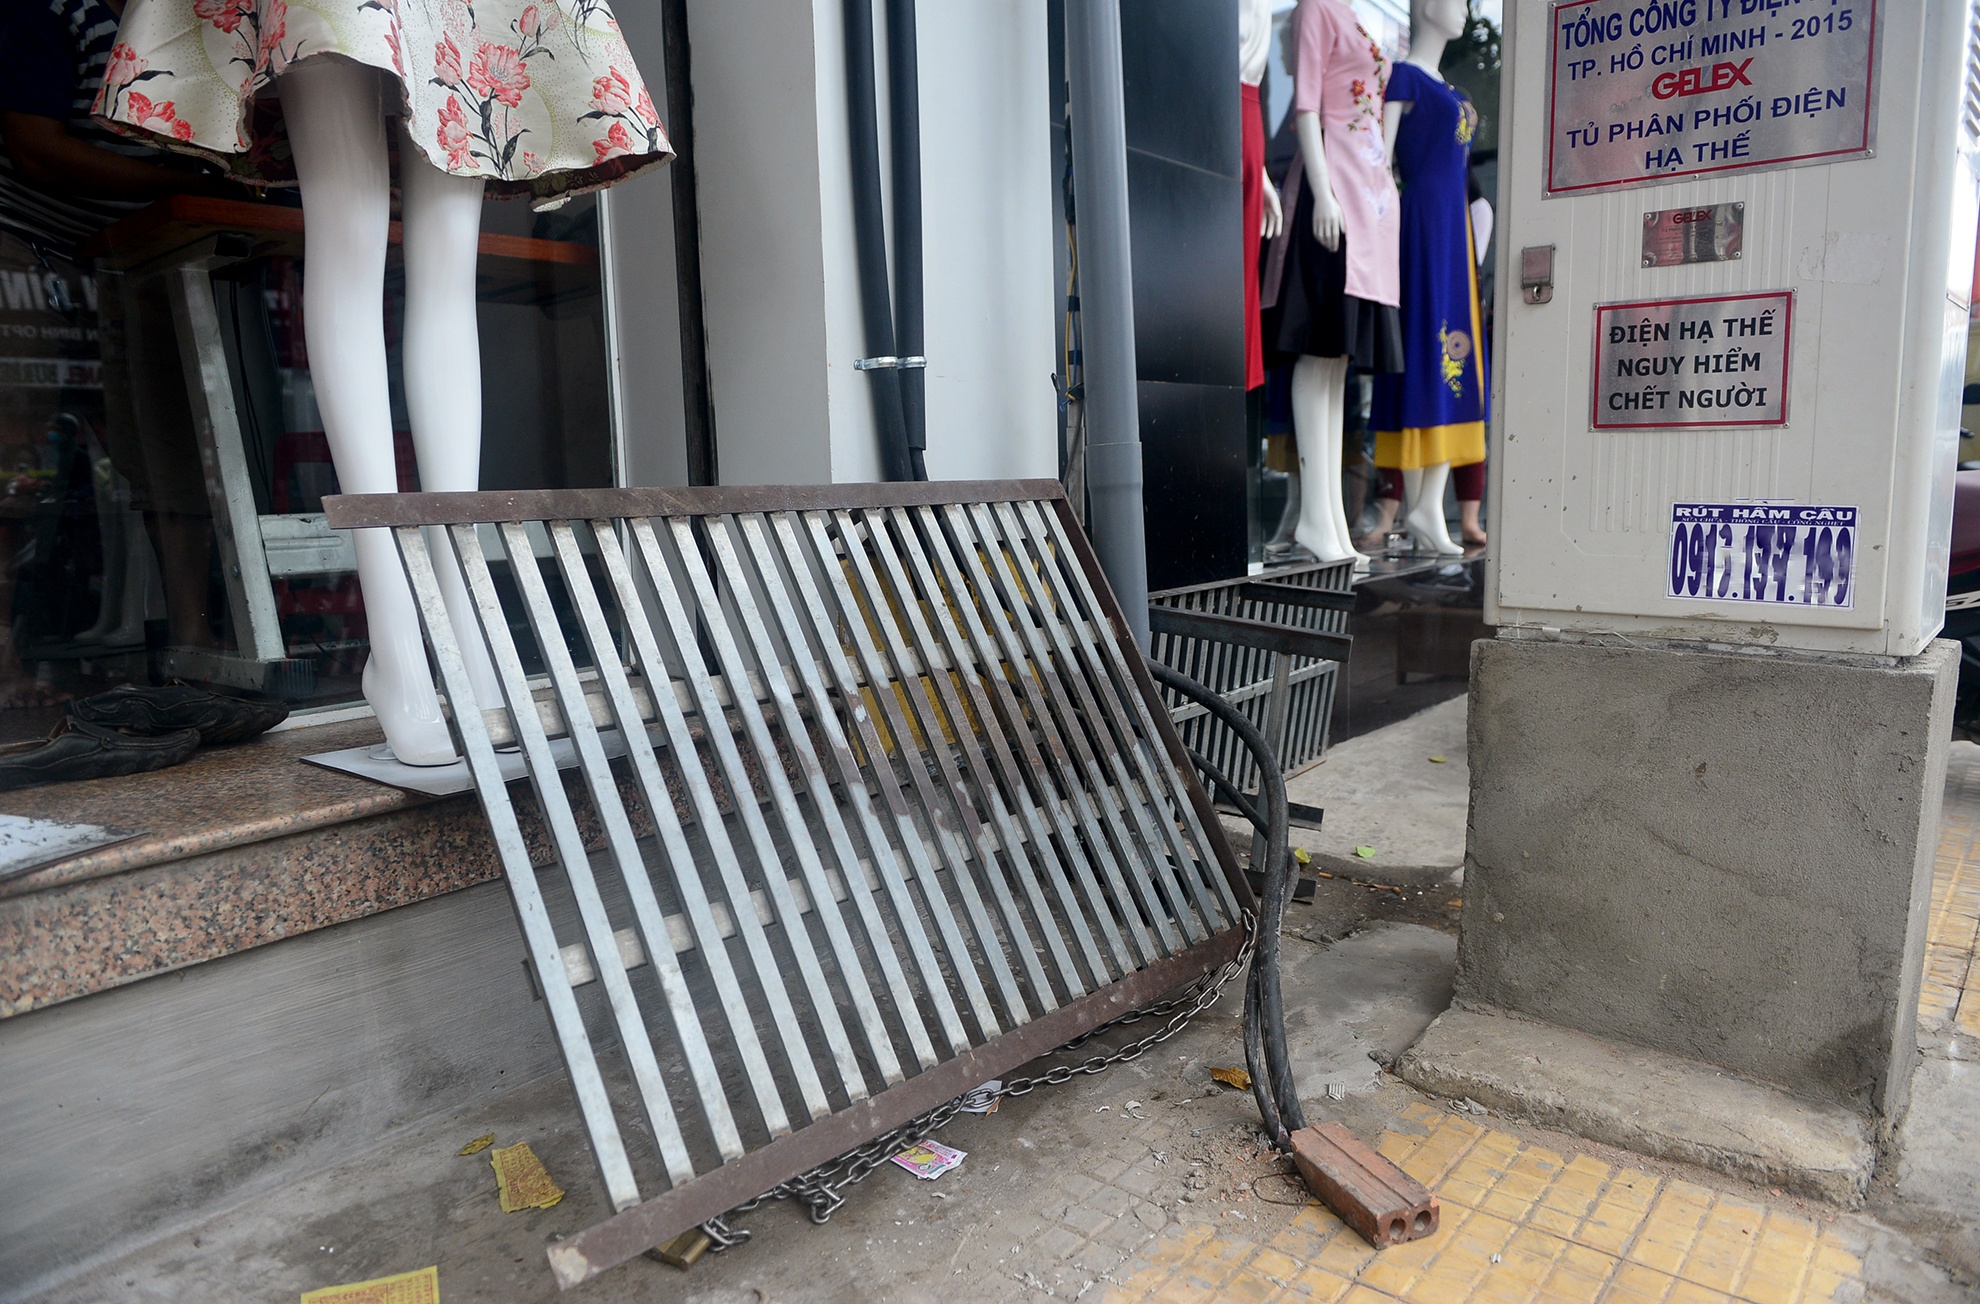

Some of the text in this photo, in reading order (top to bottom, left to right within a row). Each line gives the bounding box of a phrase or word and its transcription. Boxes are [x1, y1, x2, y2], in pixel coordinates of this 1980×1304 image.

[1562, 0, 1801, 50] TỔNG CÔNG TY ĐI
[1568, 62, 1602, 81] TP.
[1610, 45, 1644, 74] HỒ
[1651, 40, 1692, 66] CHÍ
[1700, 29, 1765, 57] MINH
[1790, 9, 1854, 41] 2015
[1651, 57, 1755, 100] GELEX
[1566, 87, 1846, 149] TỦ PHÂN PHỐI ĐIỆN
[1645, 129, 1751, 172] HẠ THẾ
[1673, 209, 1712, 224] GELEX
[1609, 309, 1777, 347] ĐIỆN HẠ THẾ
[1617, 347, 1760, 377] NGUY HIỂM
[1609, 382, 1767, 411] CHẾT NGƯỜI
[1676, 506, 1724, 517] RÚT
